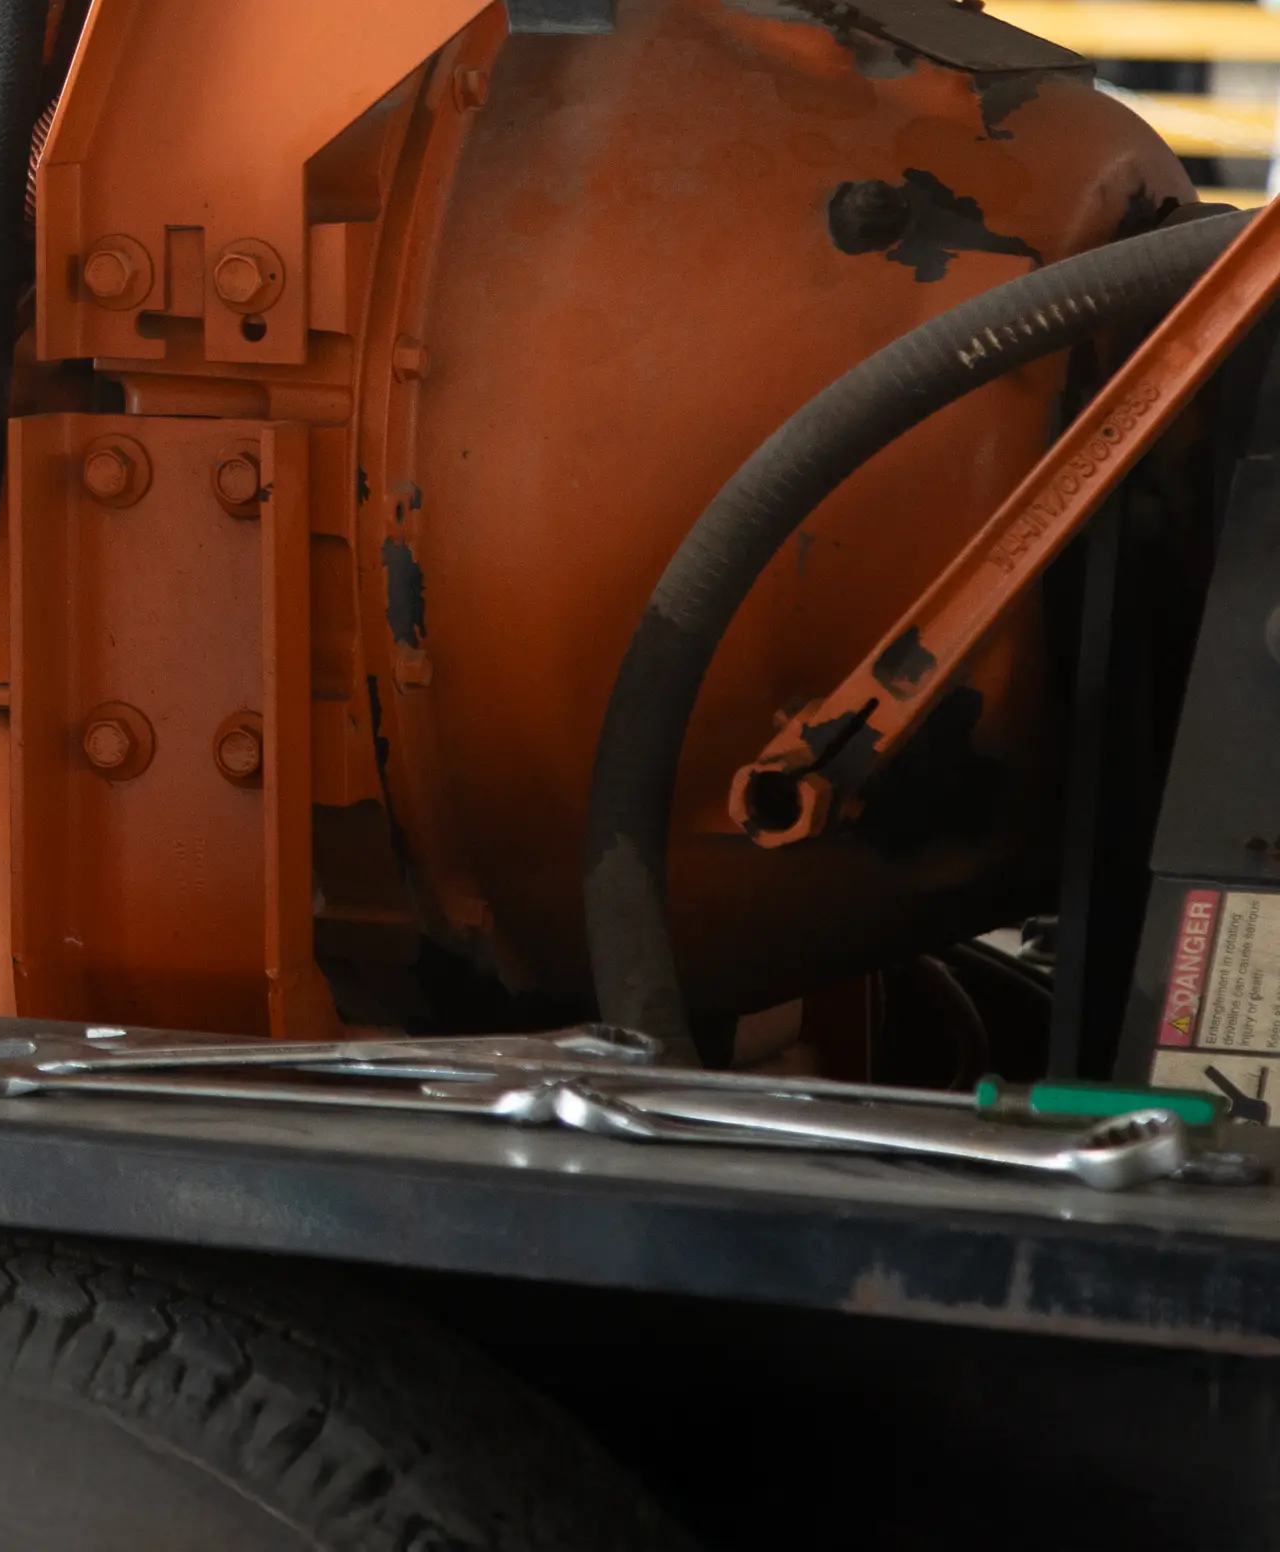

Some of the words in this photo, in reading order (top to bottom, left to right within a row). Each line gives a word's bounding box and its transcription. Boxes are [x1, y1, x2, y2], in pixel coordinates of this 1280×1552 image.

[1224, 913, 1243, 954] rotating
[1243, 901, 1261, 939] serious
[1172, 901, 1213, 1008] DANGER
[1222, 956, 1233, 967] in
[1238, 943, 1252, 975] cause
[1234, 977, 1245, 997] can
[1206, 968, 1229, 1045] Entanglement
[1223, 1000, 1241, 1046] driveline
[1246, 1002, 1257, 1014] or
[1240, 1016, 1258, 1047] injury
